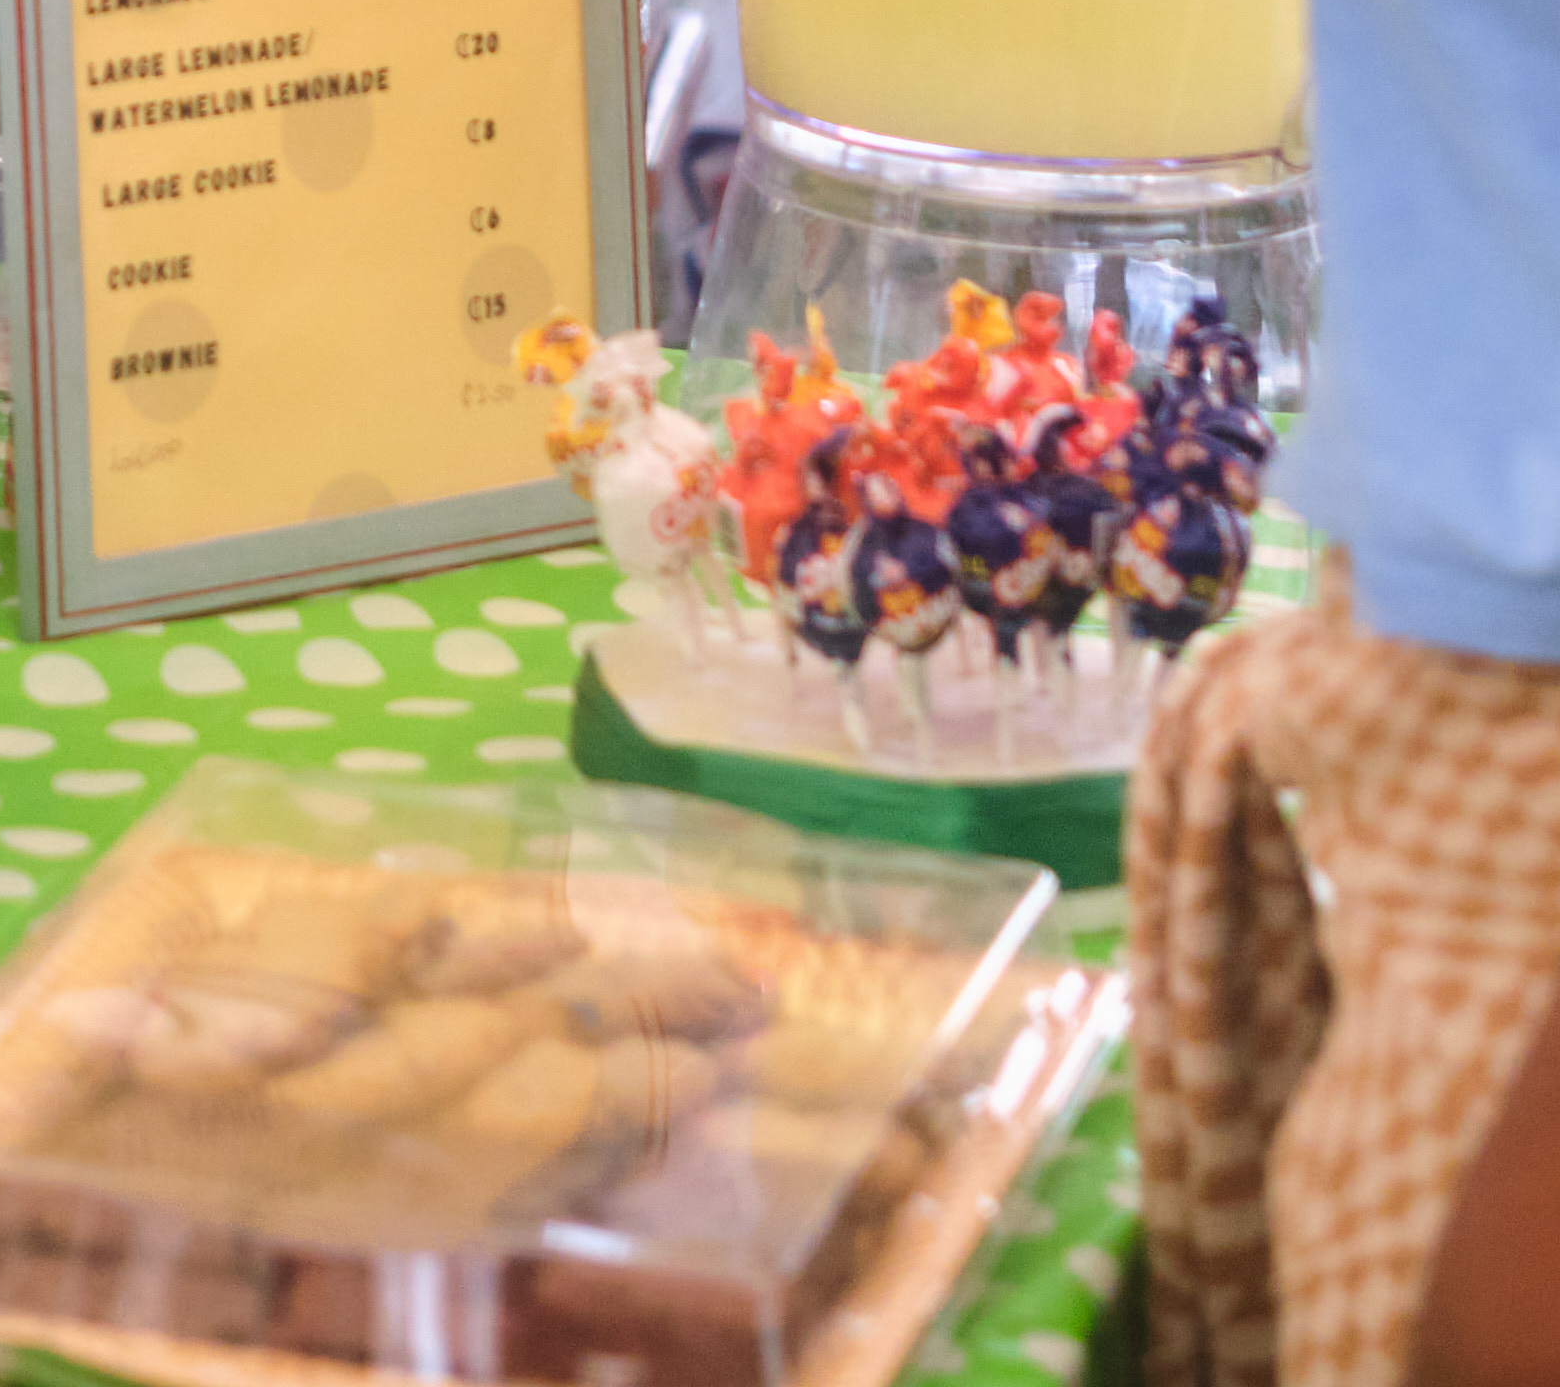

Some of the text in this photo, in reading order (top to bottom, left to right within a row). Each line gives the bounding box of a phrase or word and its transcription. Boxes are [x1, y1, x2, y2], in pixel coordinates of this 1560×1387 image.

[87, 52, 165, 88] LARGE
[88, 66, 390, 135] WATERMELON LEMONADE
[102, 158, 277, 210] LARGE COOKIE
[107, 254, 193, 291] COOKIE
[110, 340, 219, 383] BROWNIE
